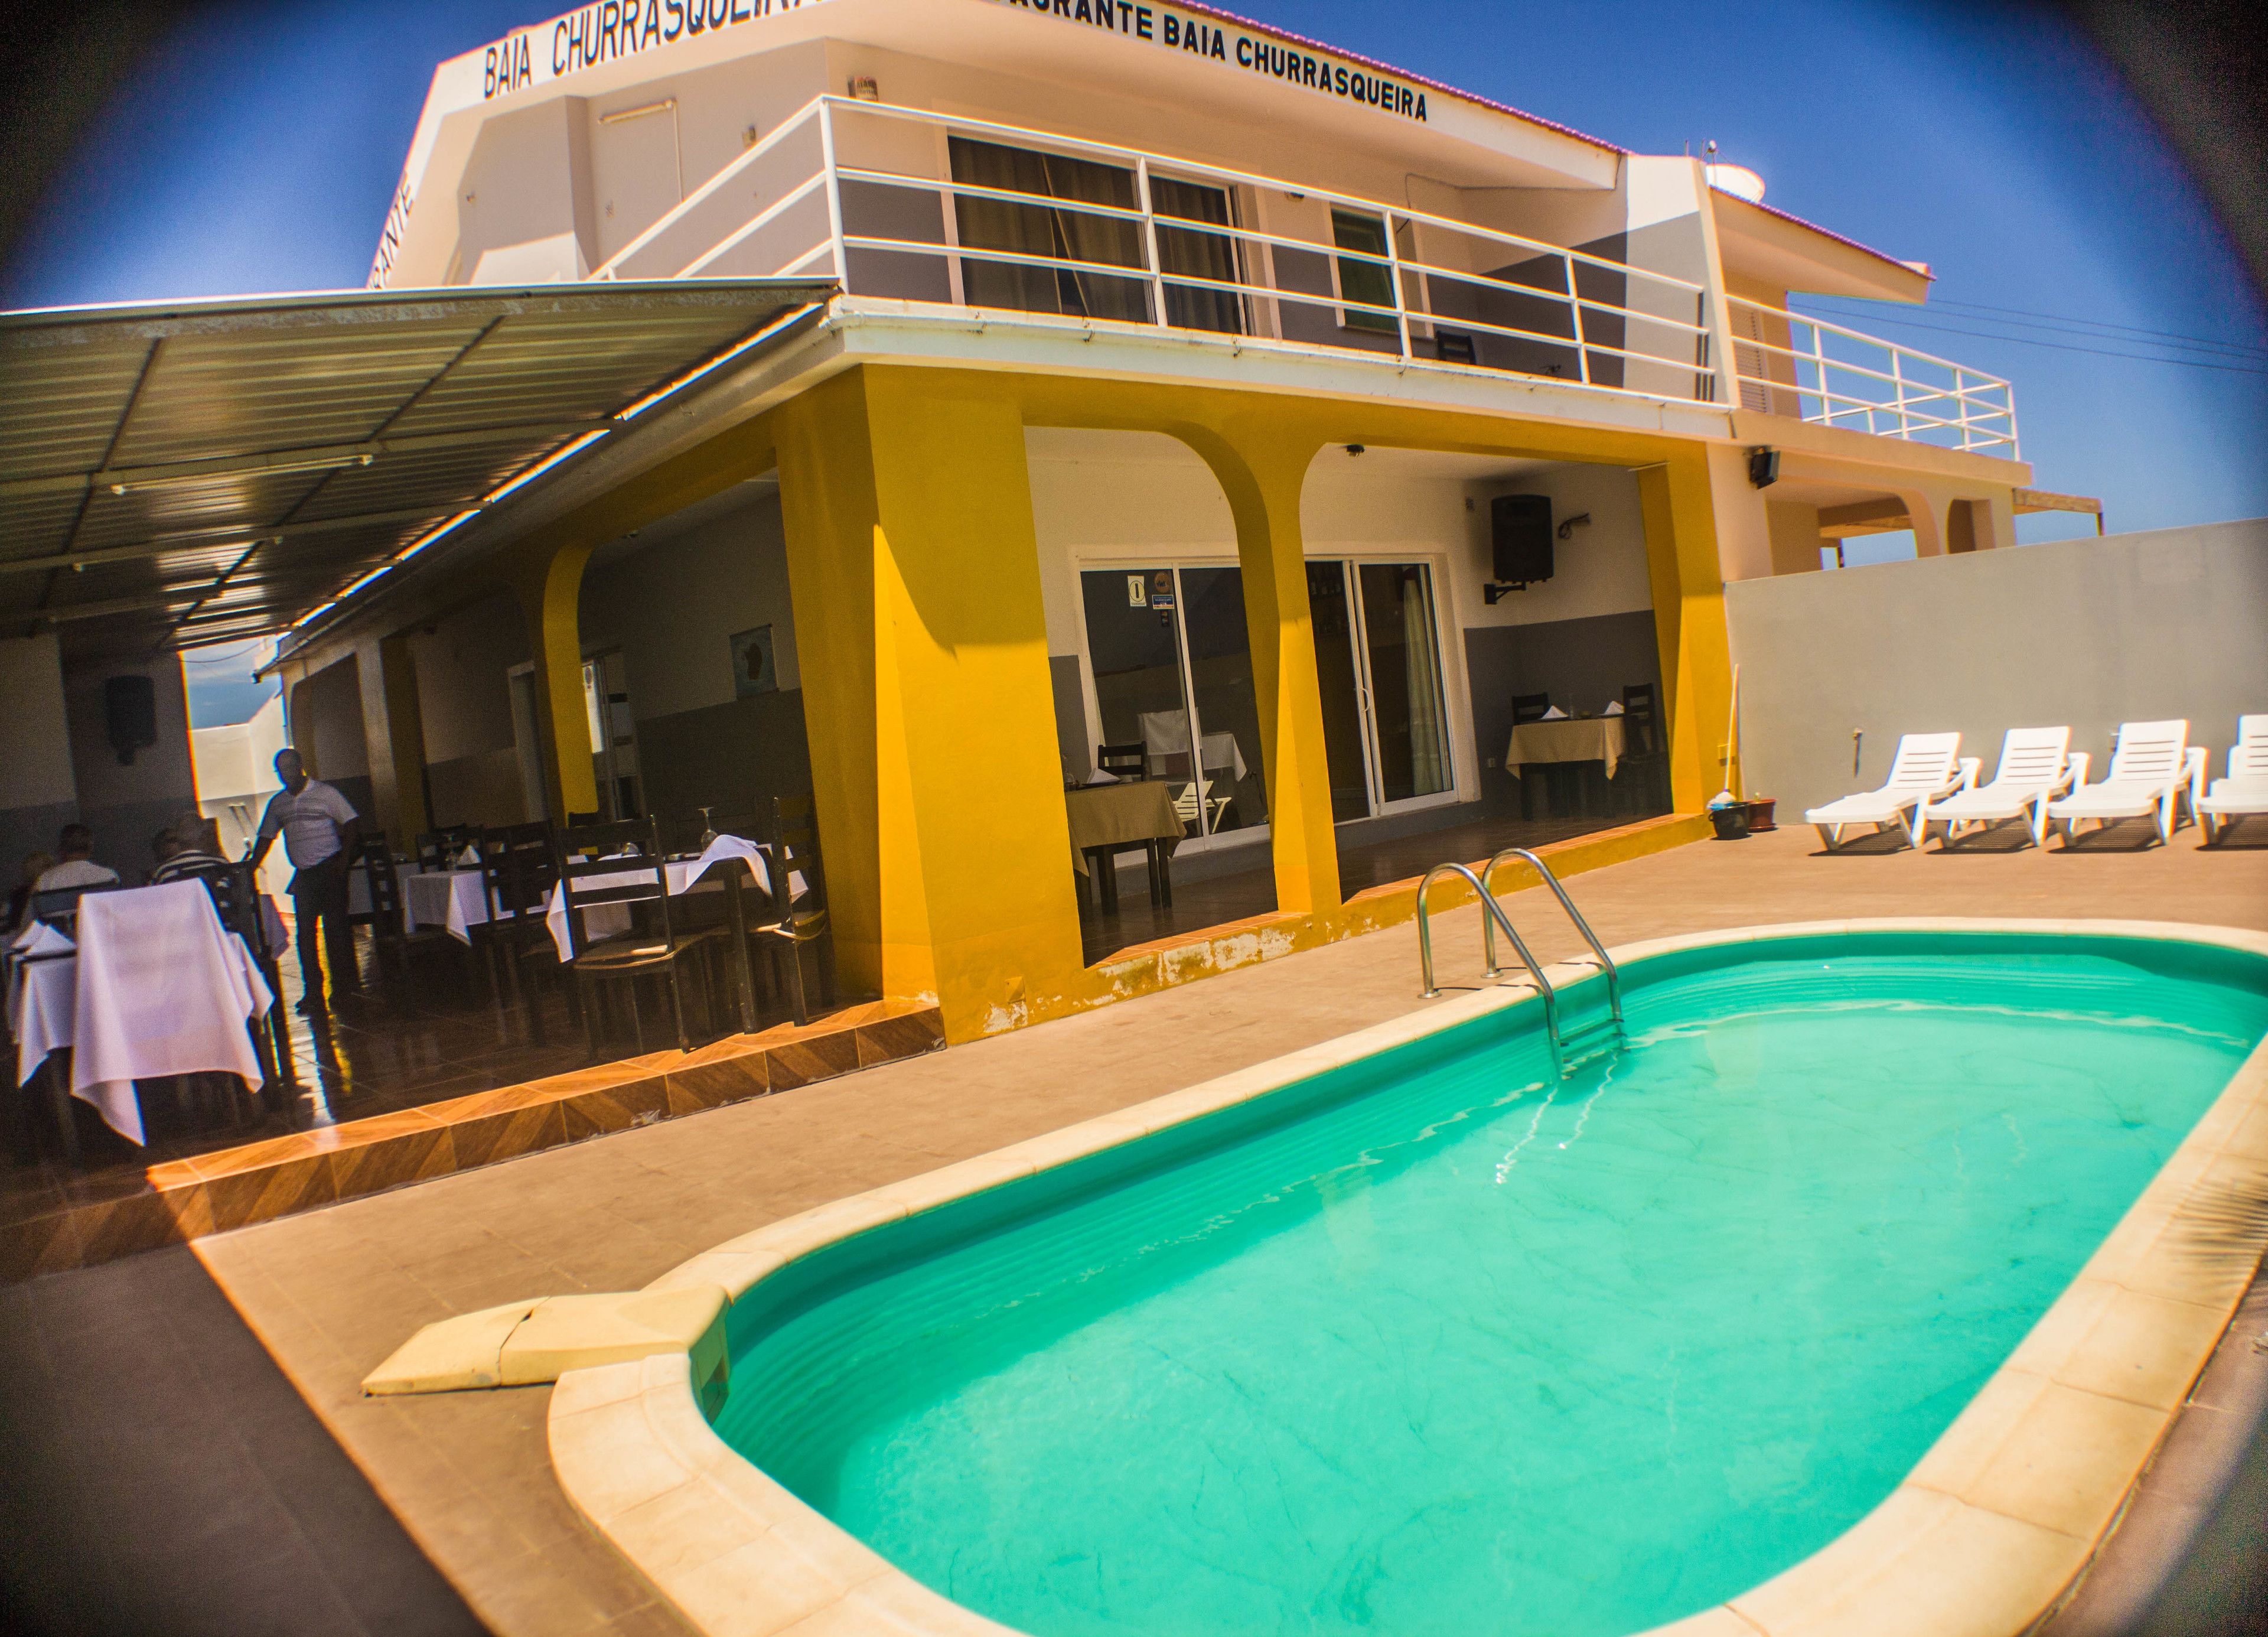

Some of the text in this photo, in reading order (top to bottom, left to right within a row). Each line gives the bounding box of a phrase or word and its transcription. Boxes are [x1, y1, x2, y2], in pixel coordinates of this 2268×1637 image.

[485, 0, 823, 100] BAIA CHURRASQ
[1164, 14, 1226, 61] BAIA
[1236, 36, 1427, 122] CHURRASQUEIRA
